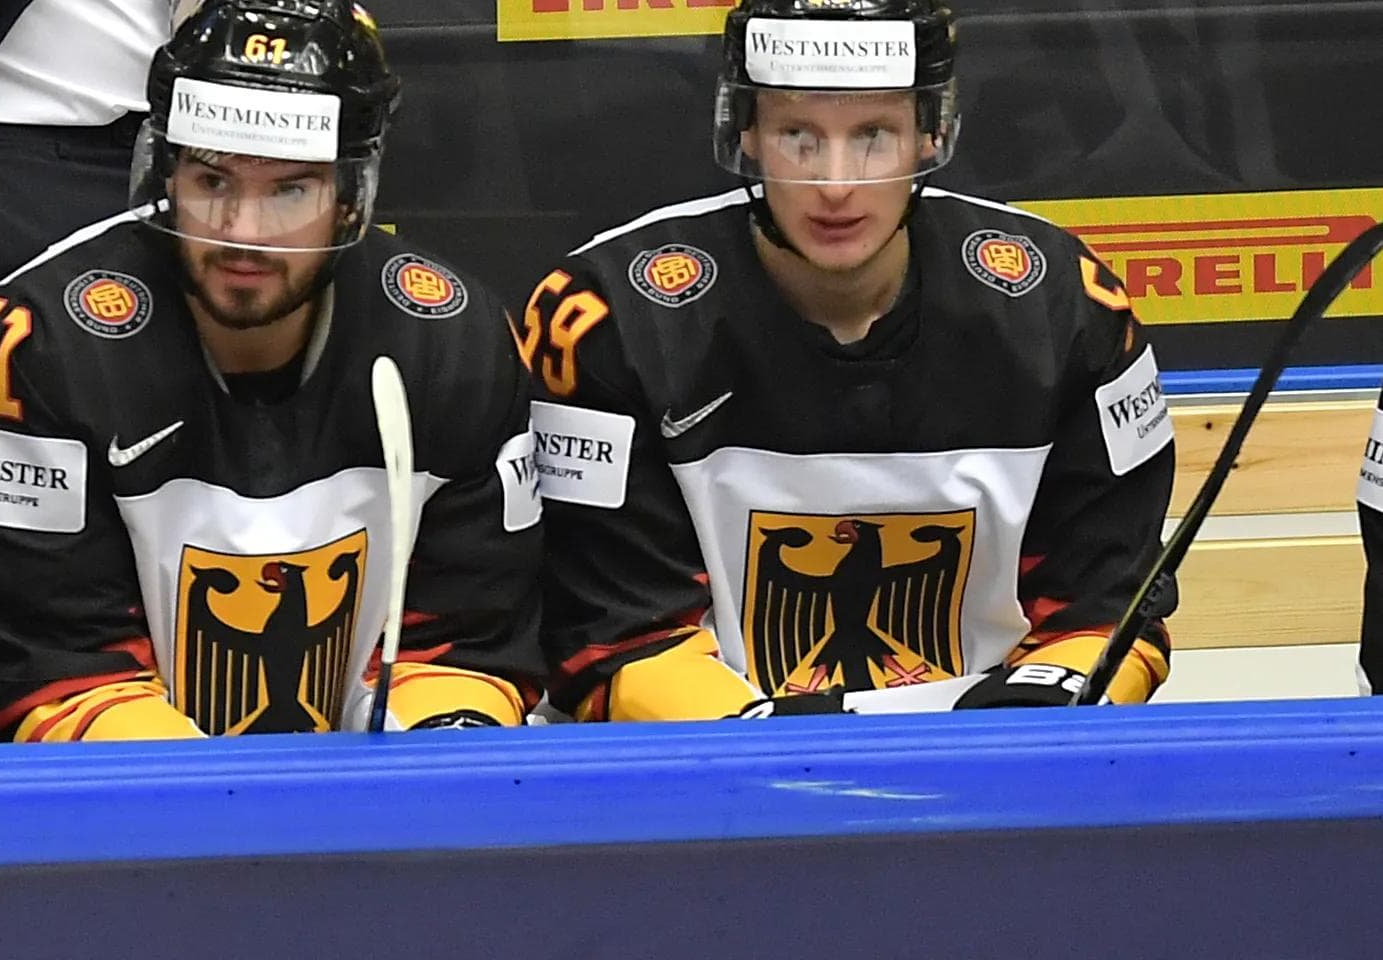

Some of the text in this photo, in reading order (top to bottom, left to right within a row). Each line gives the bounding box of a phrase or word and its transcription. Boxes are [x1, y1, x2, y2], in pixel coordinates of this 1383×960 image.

[244, 34, 287, 64] 61
[751, 32, 909, 57] WESTMINSTER
[177, 91, 331, 131] WESTMINSTER
[521, 268, 609, 396] 59
